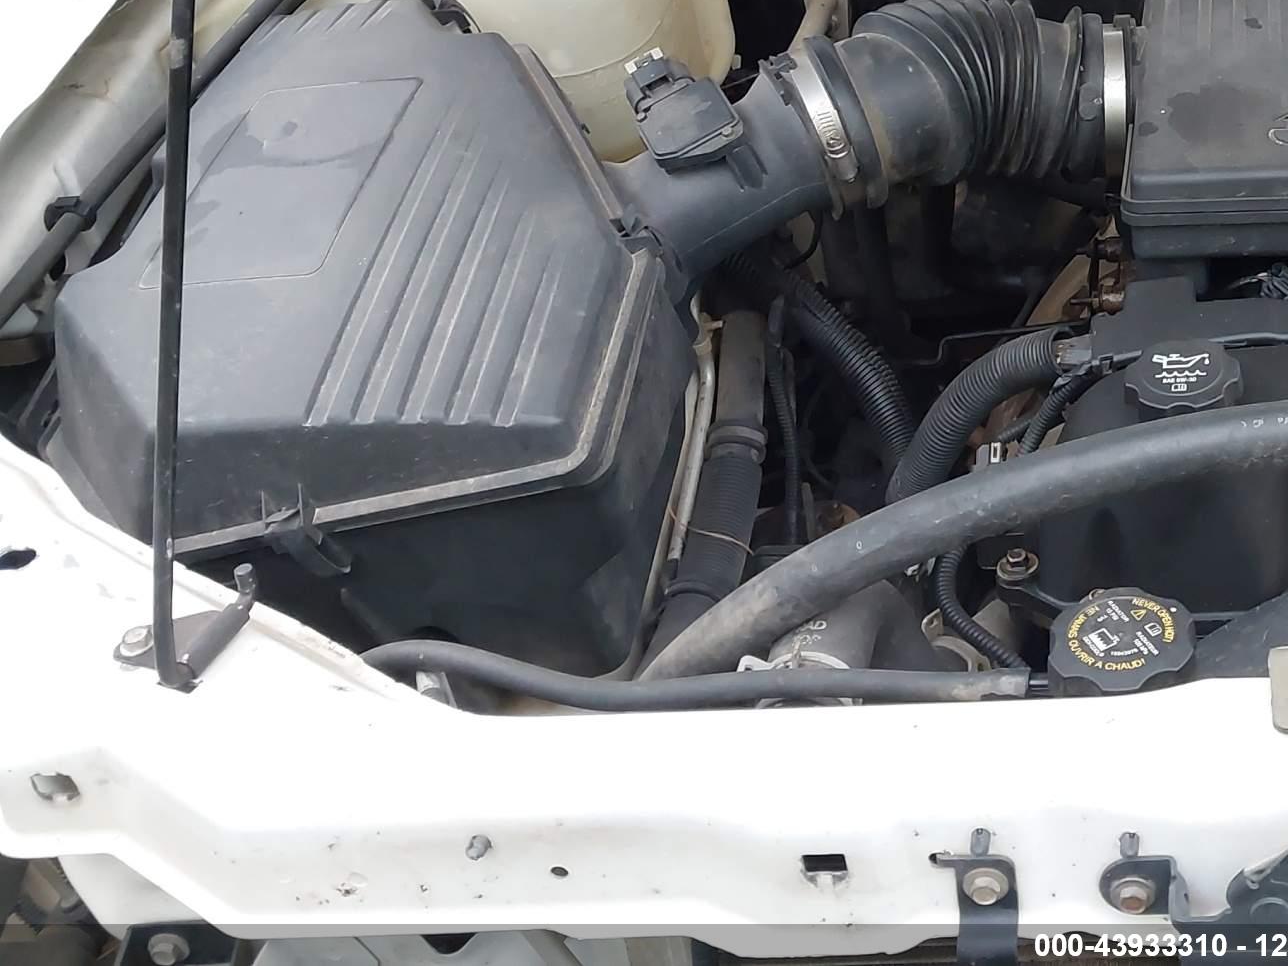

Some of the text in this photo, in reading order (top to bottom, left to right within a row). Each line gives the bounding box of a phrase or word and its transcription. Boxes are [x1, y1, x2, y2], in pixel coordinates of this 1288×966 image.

[1131, 598, 1159, 613] NEVER
[1157, 609, 1174, 628] OPEN
[1068, 639, 1095, 666] OUVRIR
[1095, 661, 1103, 669] A
[1104, 658, 1146, 671] CHAUD!
